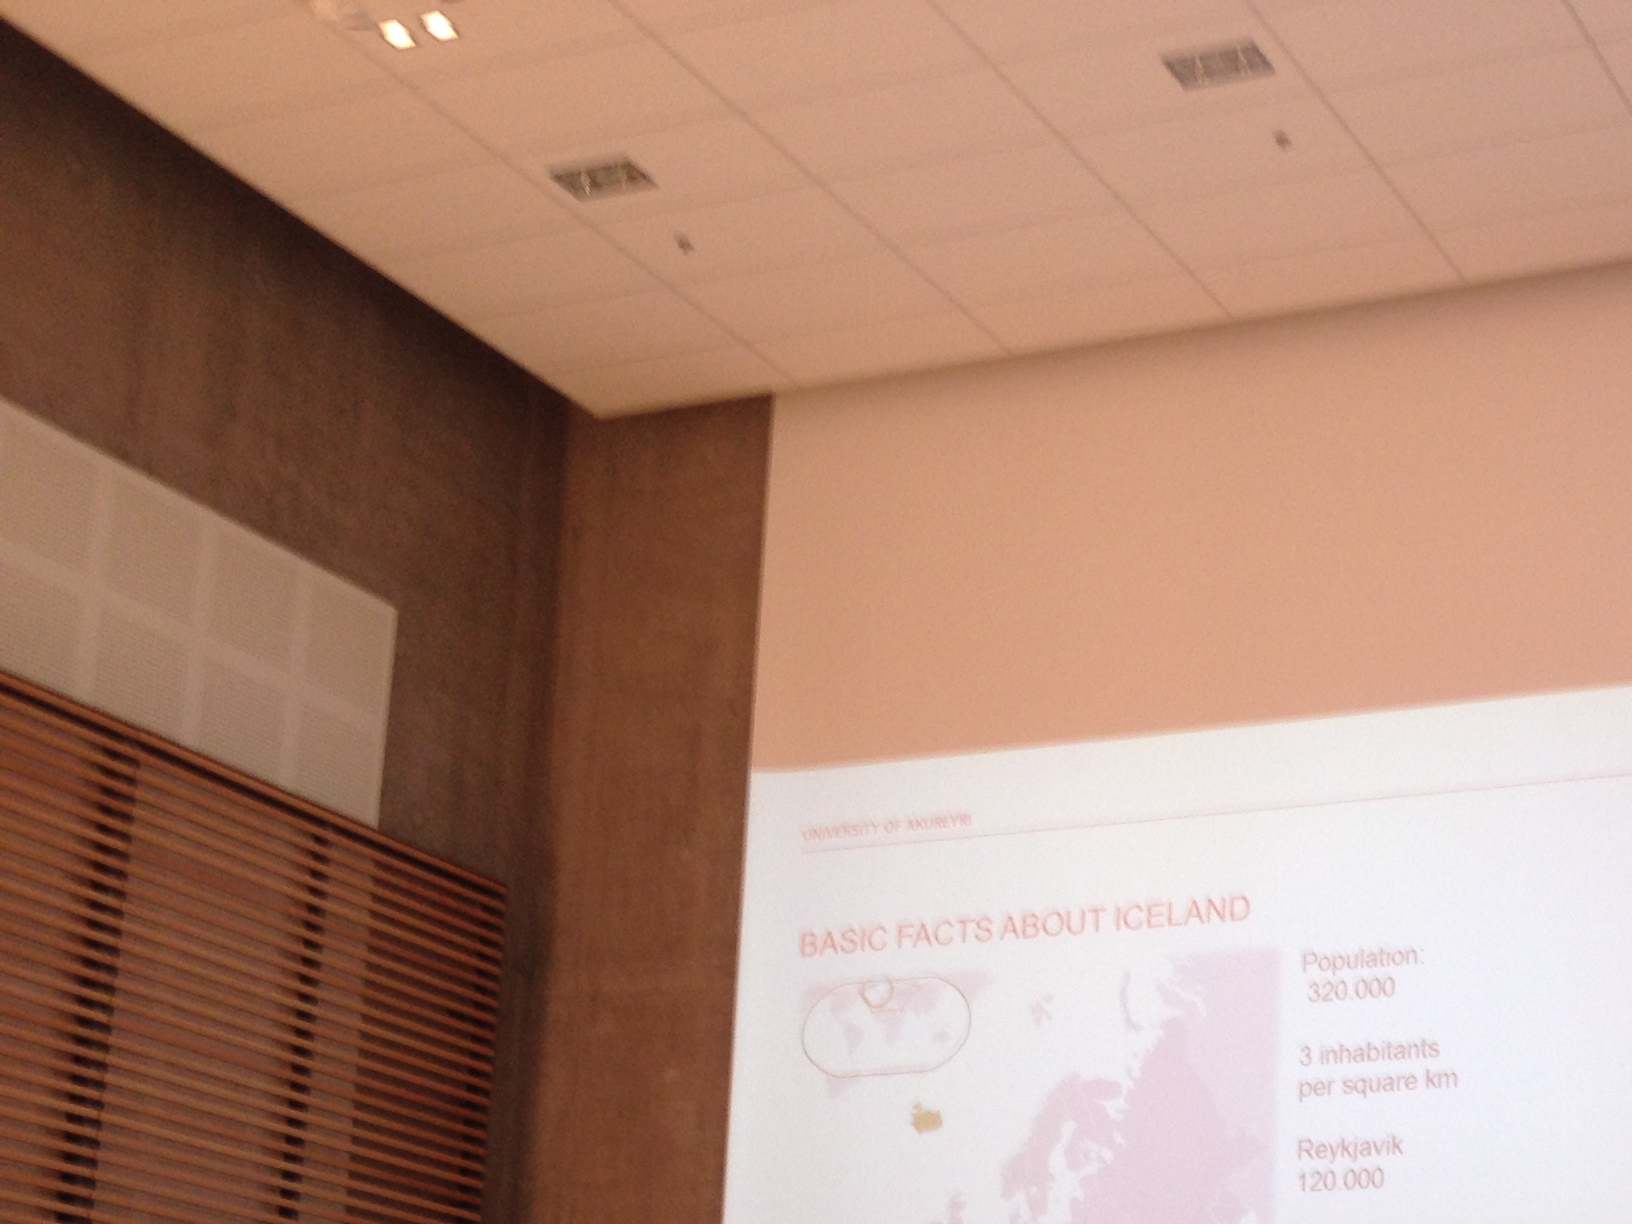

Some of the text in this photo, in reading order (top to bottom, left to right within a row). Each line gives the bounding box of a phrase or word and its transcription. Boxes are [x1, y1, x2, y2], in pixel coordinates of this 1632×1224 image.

[802, 812, 972, 841] UNIVERSITY OF AKUREYRI
[798, 894, 1252, 958] BASIC FACTS ABOUT ICELAND
[1302, 946, 1424, 976] Population:
[1307, 976, 1396, 1003] 320.000
[1300, 1038, 1441, 1067] 3 inhabitants
[1298, 1068, 1459, 1103] per square km
[1296, 1134, 1404, 1164] Reykjavik
[1298, 1166, 1385, 1192] 120.000
